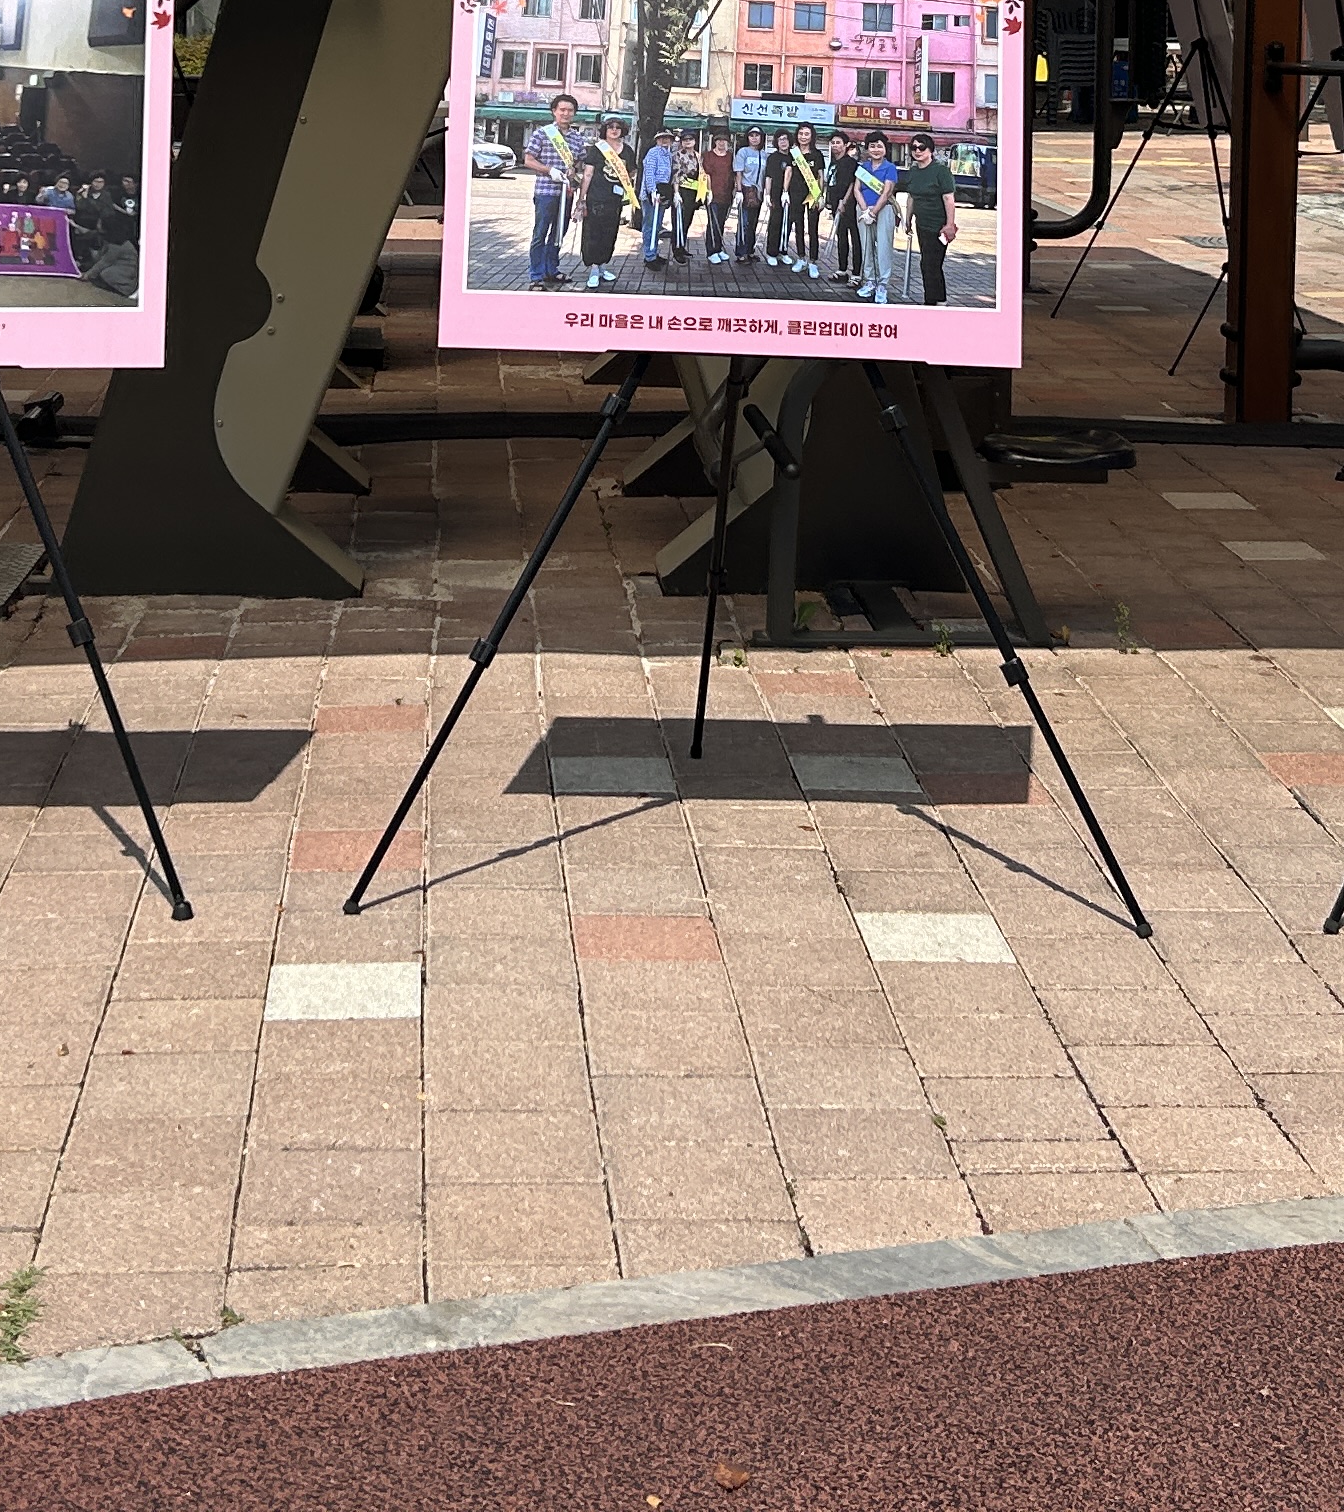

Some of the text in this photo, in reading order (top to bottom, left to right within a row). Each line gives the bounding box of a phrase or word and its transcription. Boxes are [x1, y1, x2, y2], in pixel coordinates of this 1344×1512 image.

[564, 313, 898, 339] 우리 마을은 내 손으로 깨끗하게, 클린업데이 참여
